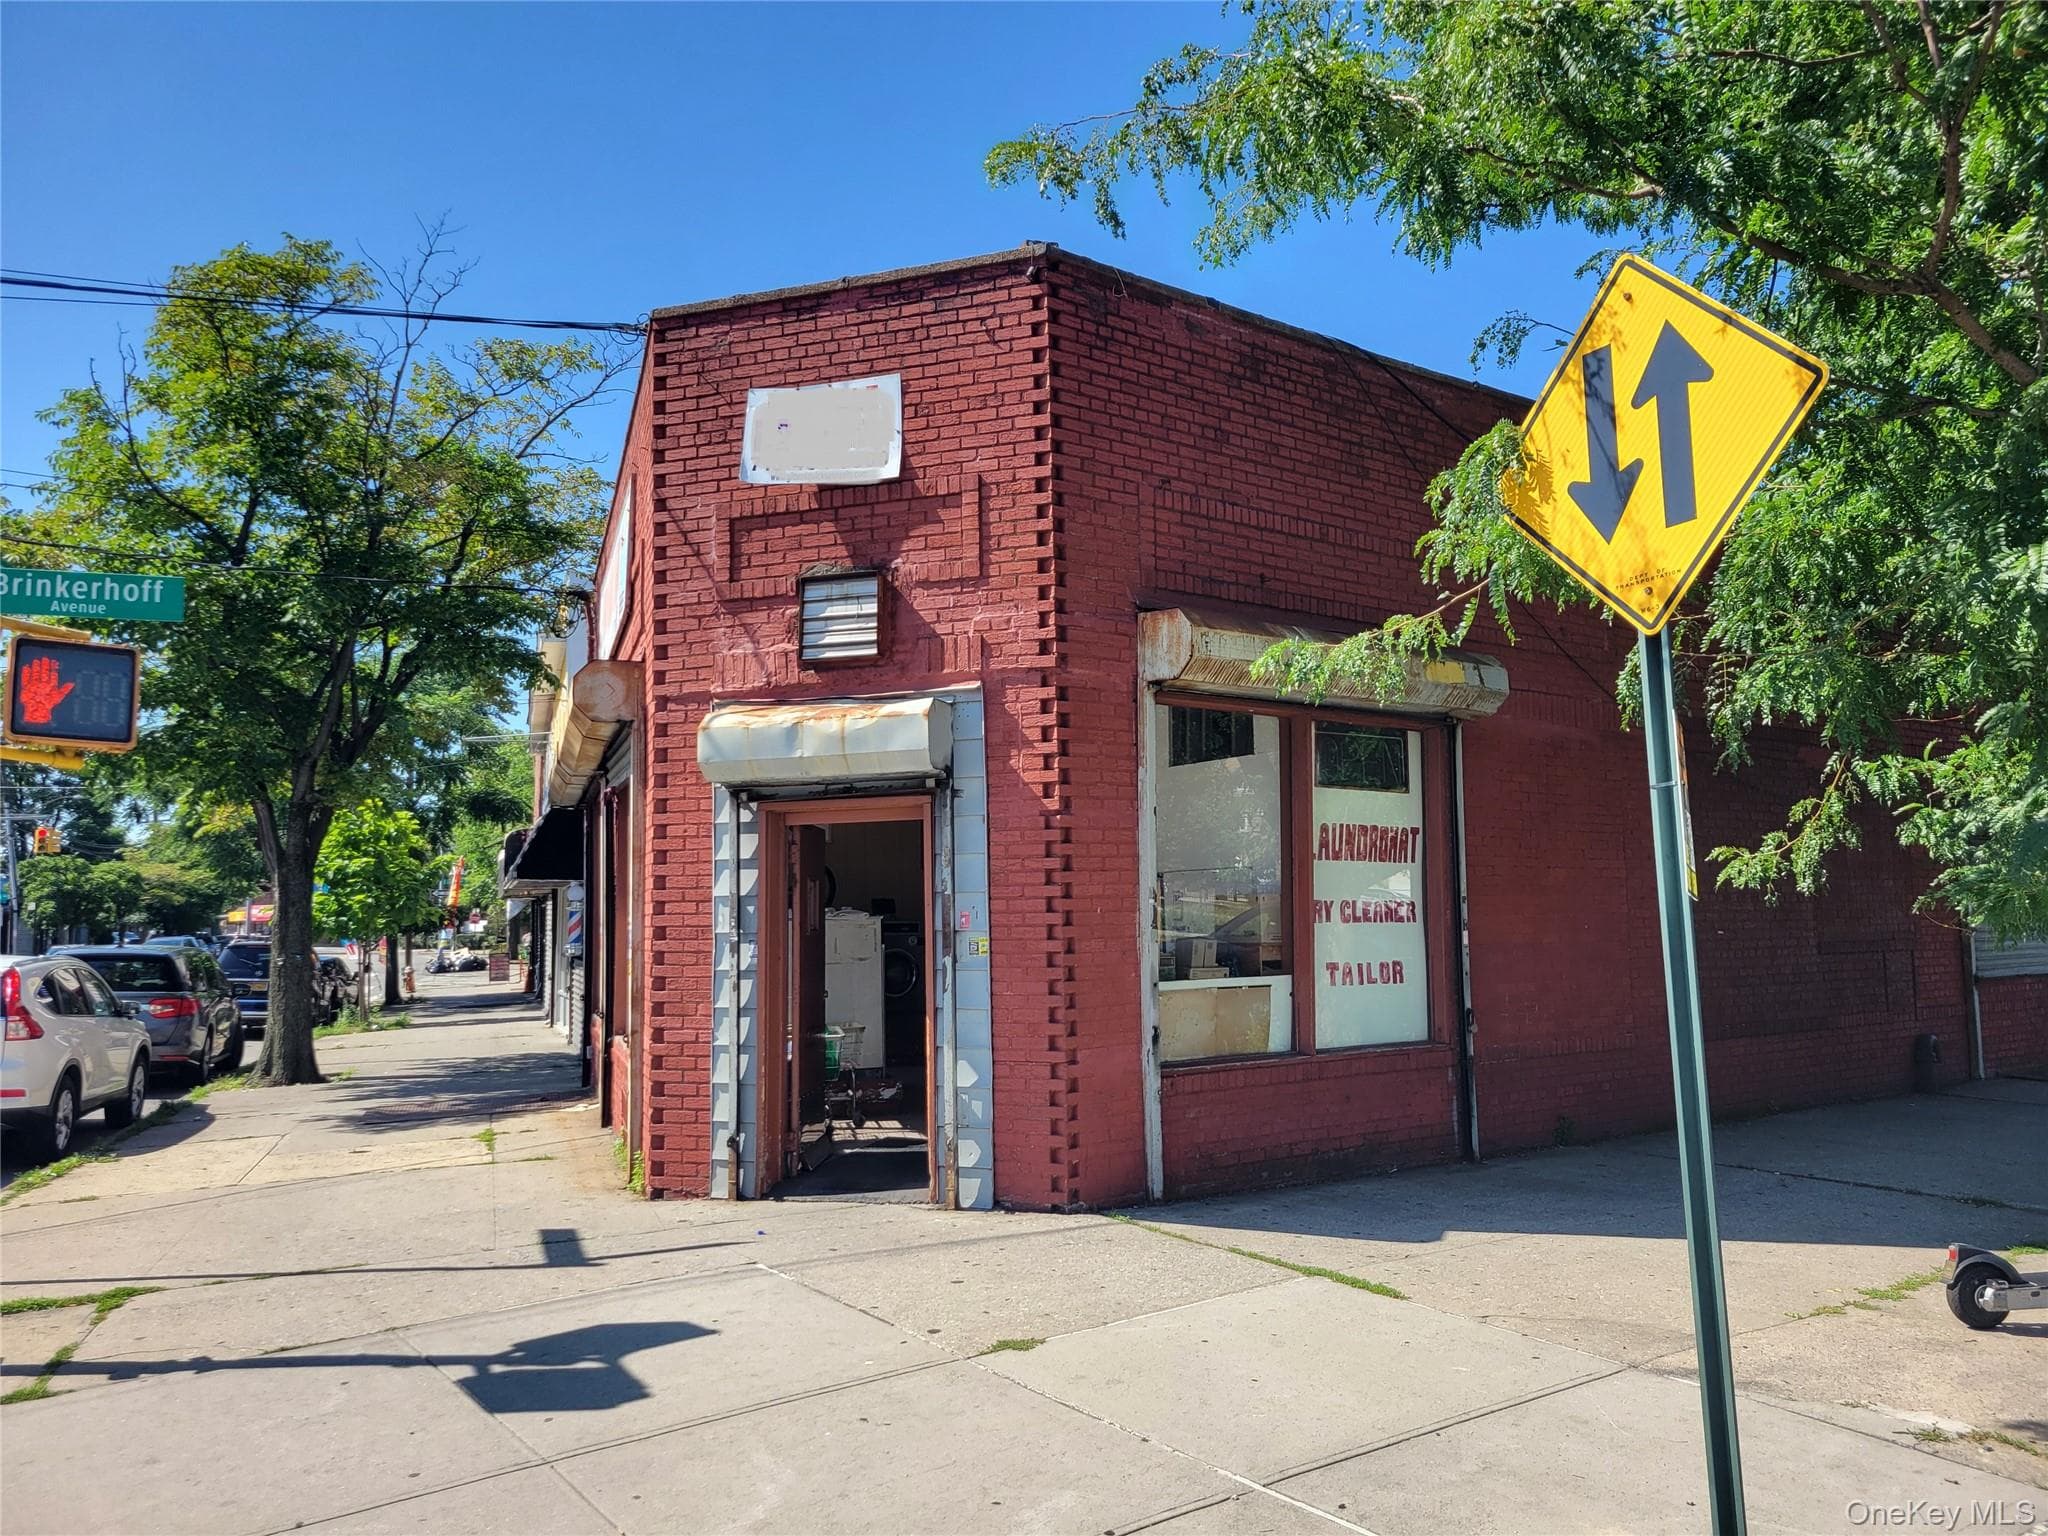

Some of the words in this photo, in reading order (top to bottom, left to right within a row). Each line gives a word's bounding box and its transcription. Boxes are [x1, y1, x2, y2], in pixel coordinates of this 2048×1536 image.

[1616, 569, 1681, 590] TRANSPORTATION
[50, 600, 107, 614] Avenue
[1313, 822, 1420, 864] AUNDROMAT
[1312, 899, 1334, 924] RY
[1339, 899, 1417, 924] CLEANER
[1325, 960, 1405, 987] TAILOR
